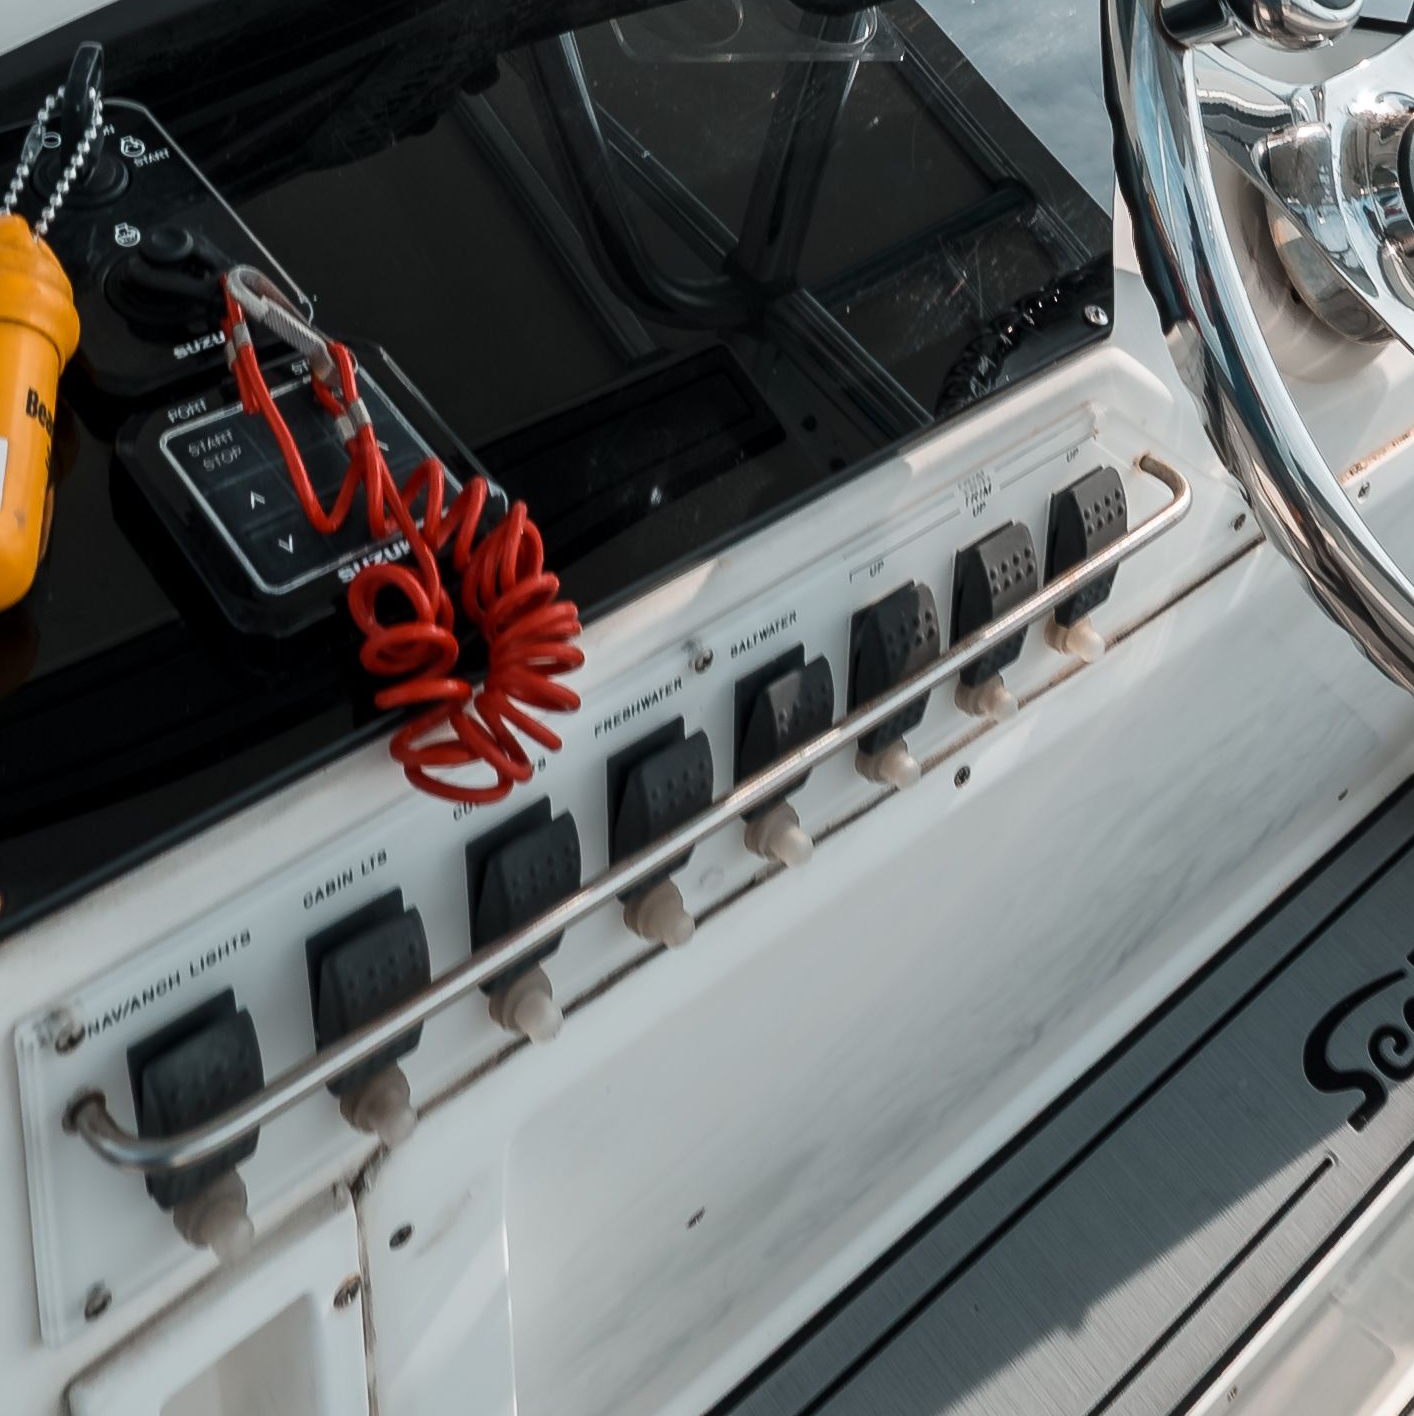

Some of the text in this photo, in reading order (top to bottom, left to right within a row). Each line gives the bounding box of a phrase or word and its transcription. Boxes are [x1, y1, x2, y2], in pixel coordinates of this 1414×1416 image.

[133, 147, 170, 168] START
[173, 330, 226, 360] SUZU
[167, 397, 207, 424] PORT
[188, 428, 234, 458] START
[1066, 447, 1079, 463] UP
[203, 445, 242, 472] STOP
[964, 484, 992, 509] TRIM
[972, 502, 986, 518] UP
[869, 560, 885, 578] UP
[730, 609, 798, 660] SALTWATER
[593, 676, 683, 739] FRESHWATER
[303, 847, 388, 911] CABIN LTS
[87, 927, 251, 1039] NAV/ANCH LIGHTS
